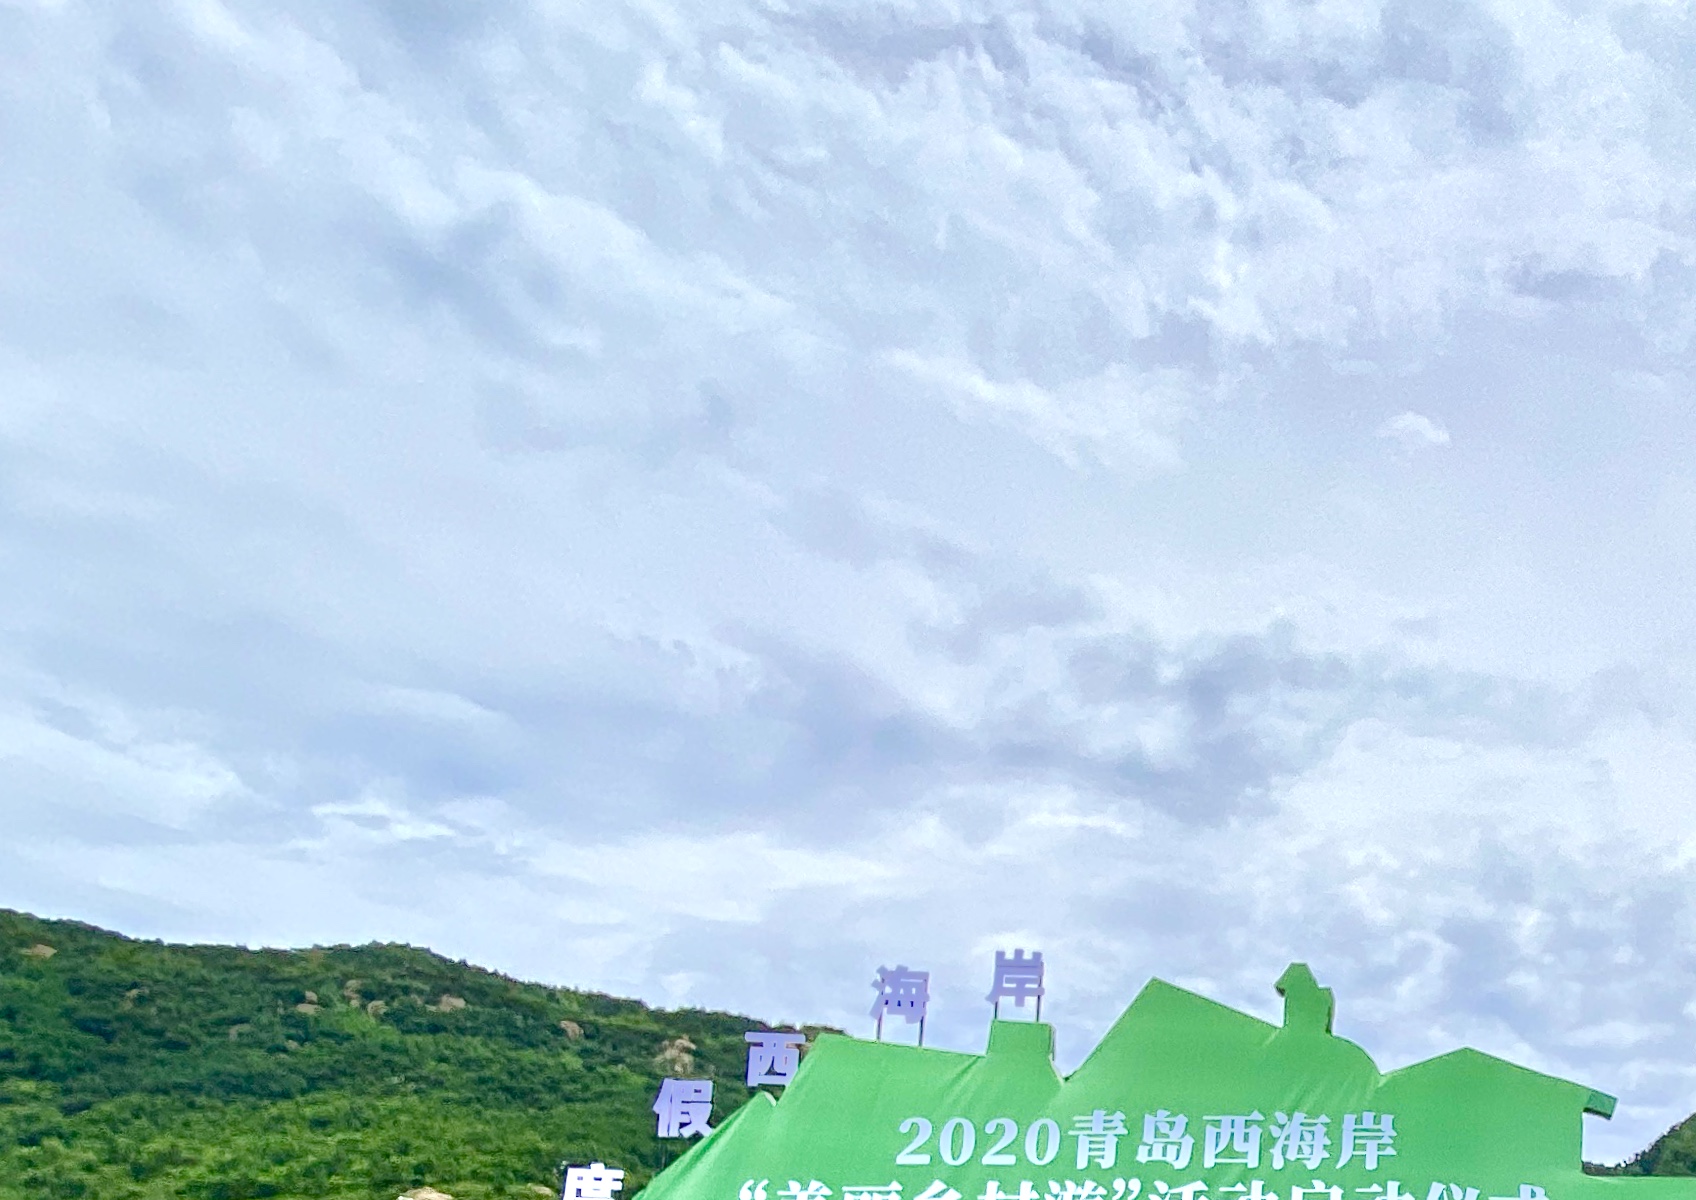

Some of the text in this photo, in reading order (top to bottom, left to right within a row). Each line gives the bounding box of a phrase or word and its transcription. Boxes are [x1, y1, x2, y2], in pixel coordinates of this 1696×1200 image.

[896, 1109, 1397, 1170] 2020青岛西海岸
